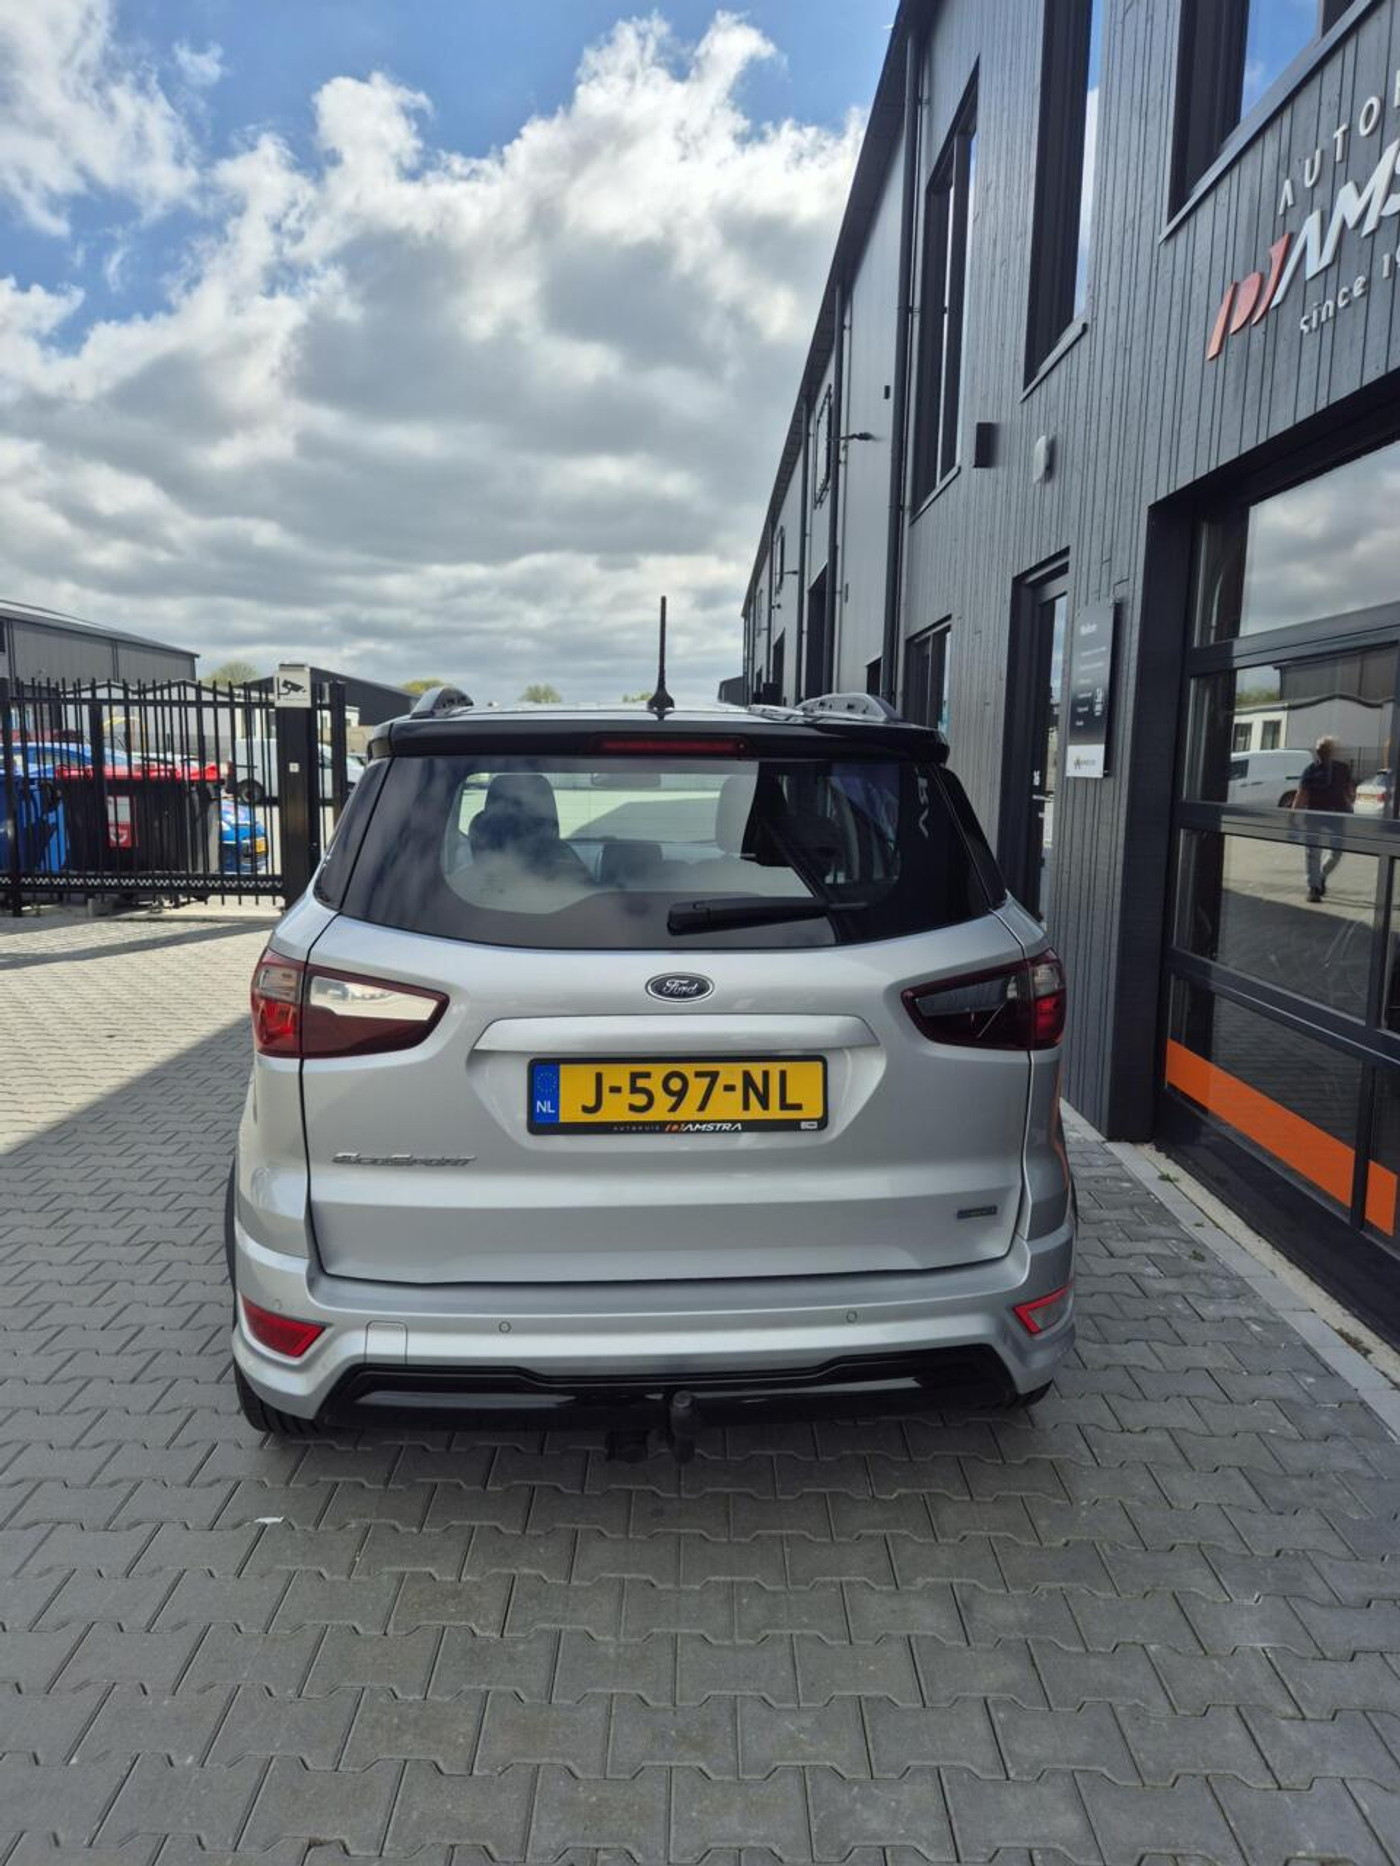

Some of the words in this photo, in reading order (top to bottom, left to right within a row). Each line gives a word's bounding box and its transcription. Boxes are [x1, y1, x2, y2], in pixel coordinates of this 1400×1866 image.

[1300, 275, 1367, 334] since
[662, 979, 699, 995] Ford
[580, 1069, 804, 1115] J-597-NL
[535, 1100, 556, 1114] NL
[682, 1122, 743, 1132] AMSTRA
